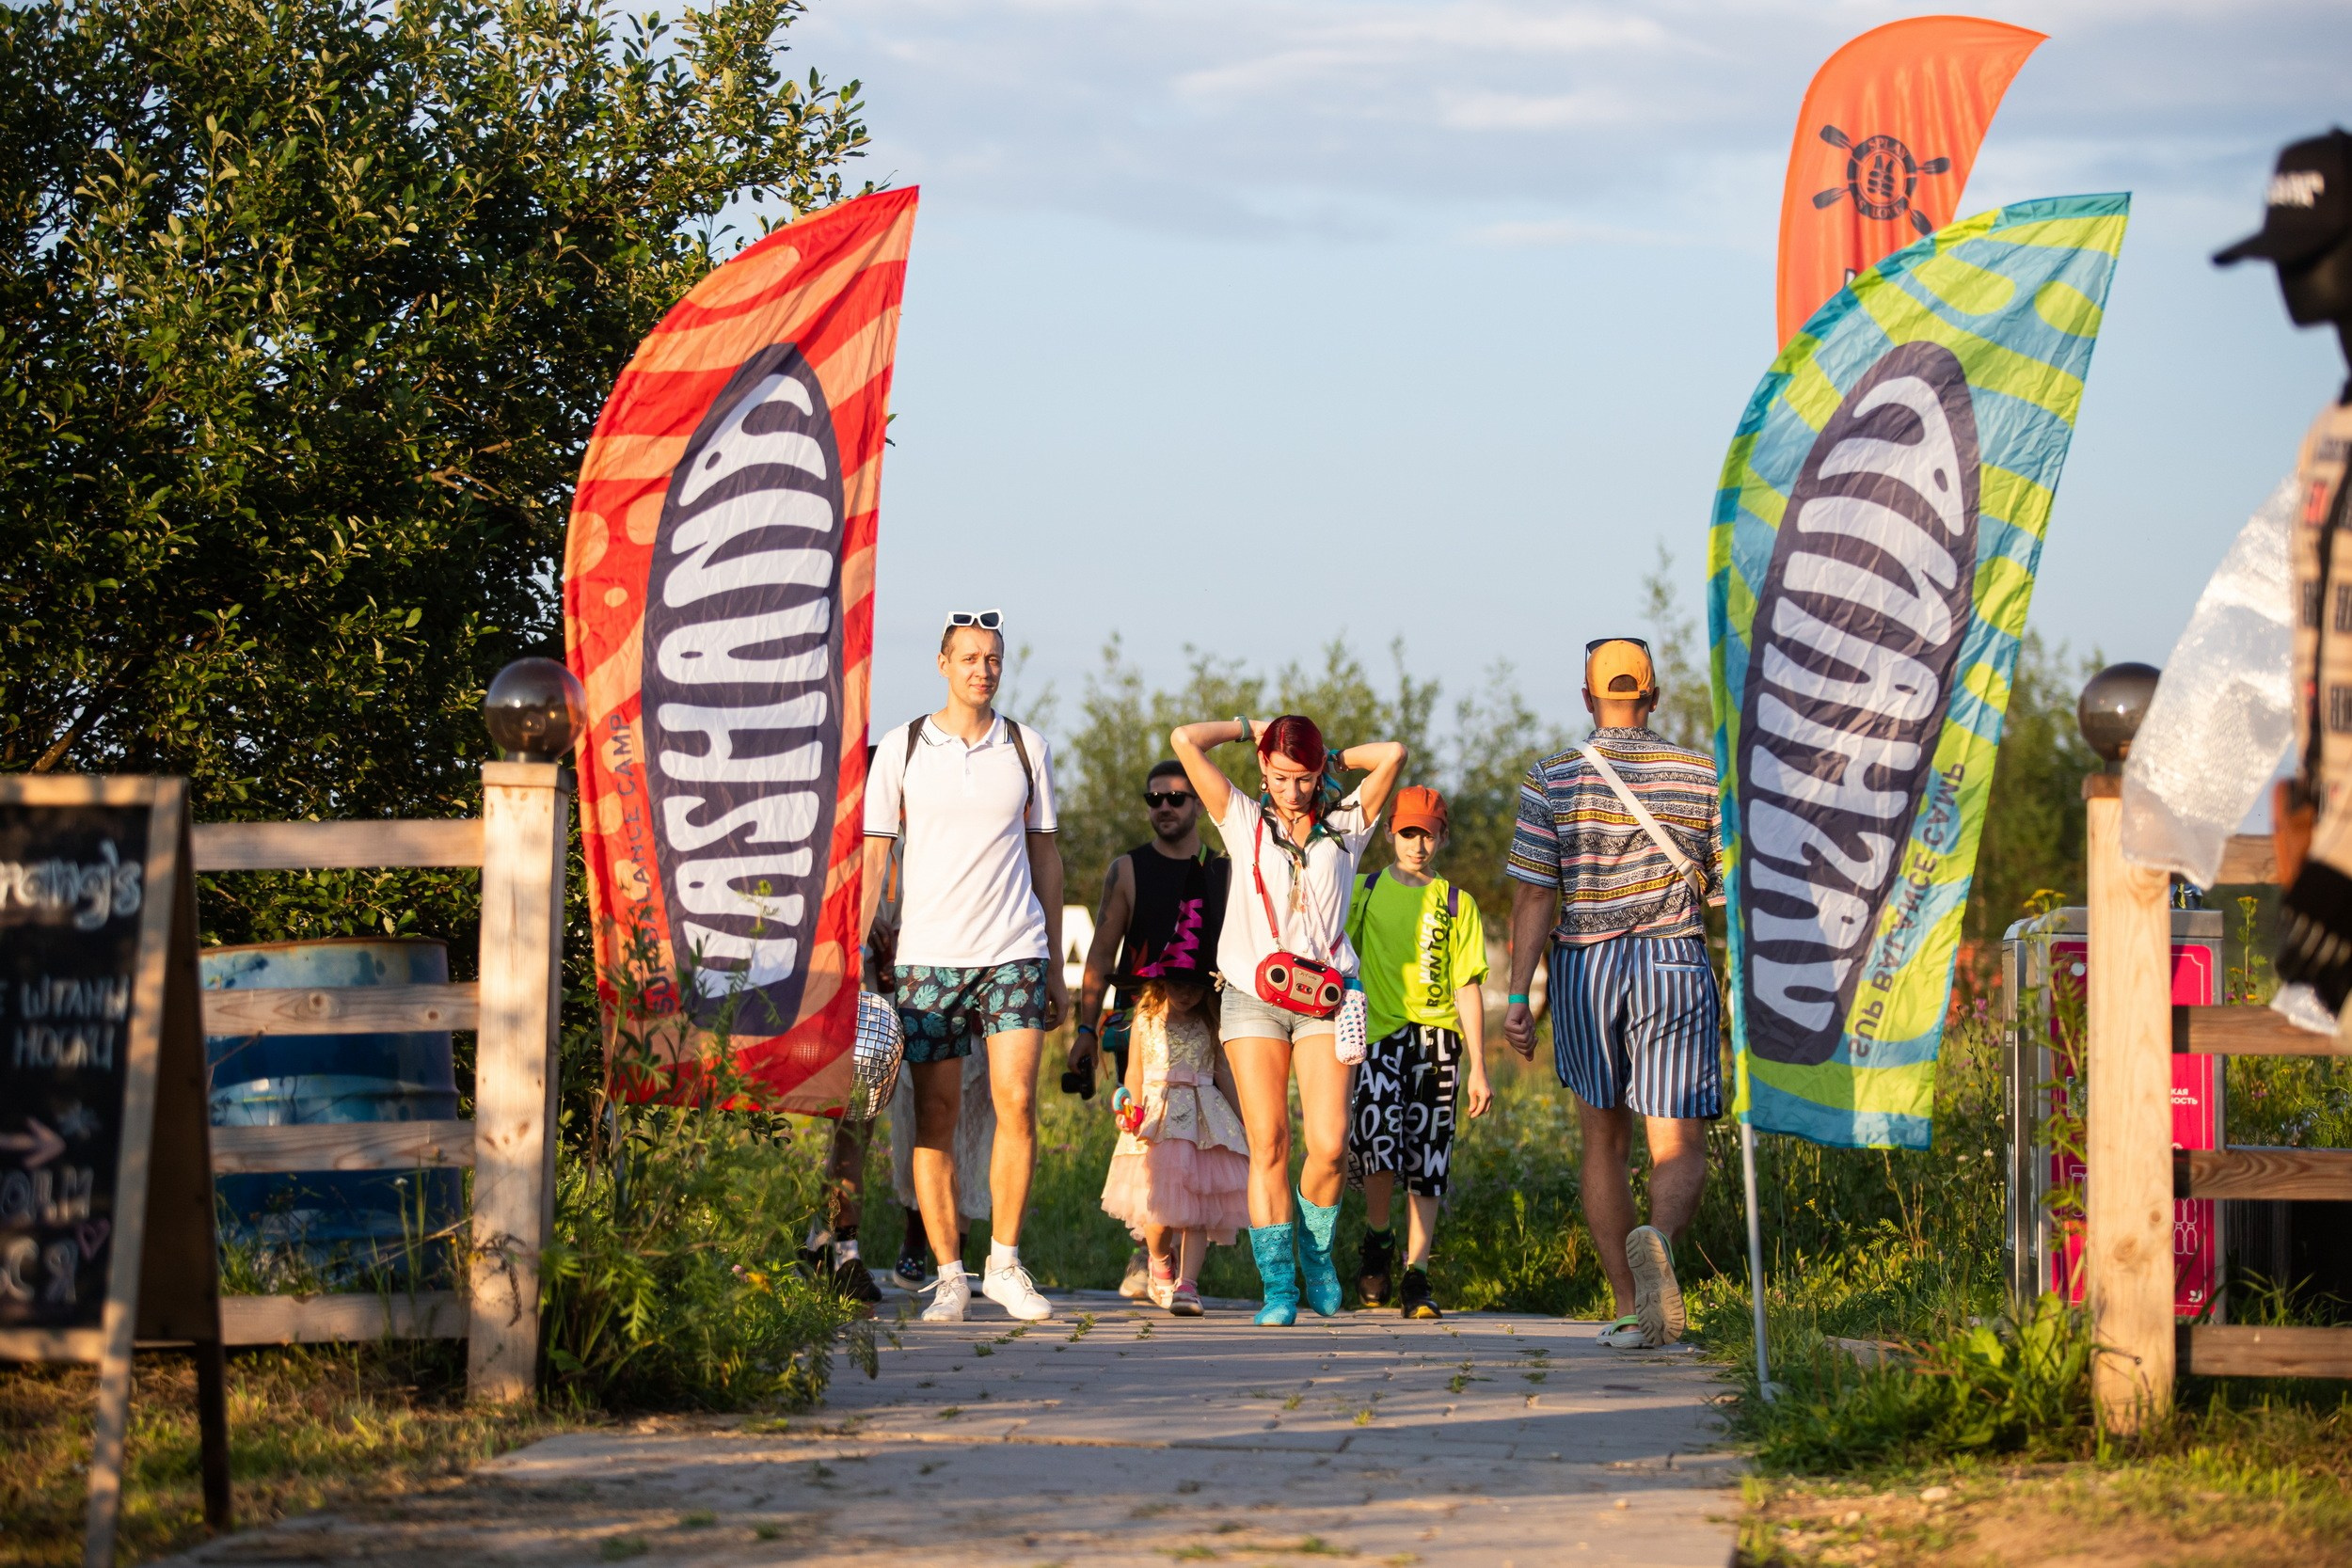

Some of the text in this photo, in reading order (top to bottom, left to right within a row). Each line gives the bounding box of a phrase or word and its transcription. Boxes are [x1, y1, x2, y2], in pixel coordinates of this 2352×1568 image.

[656, 373, 833, 998] VASHANA
[608, 712, 639, 797] CAMP
[1428, 927, 1446, 951] TO
[1426, 955, 1444, 1006] BORN
